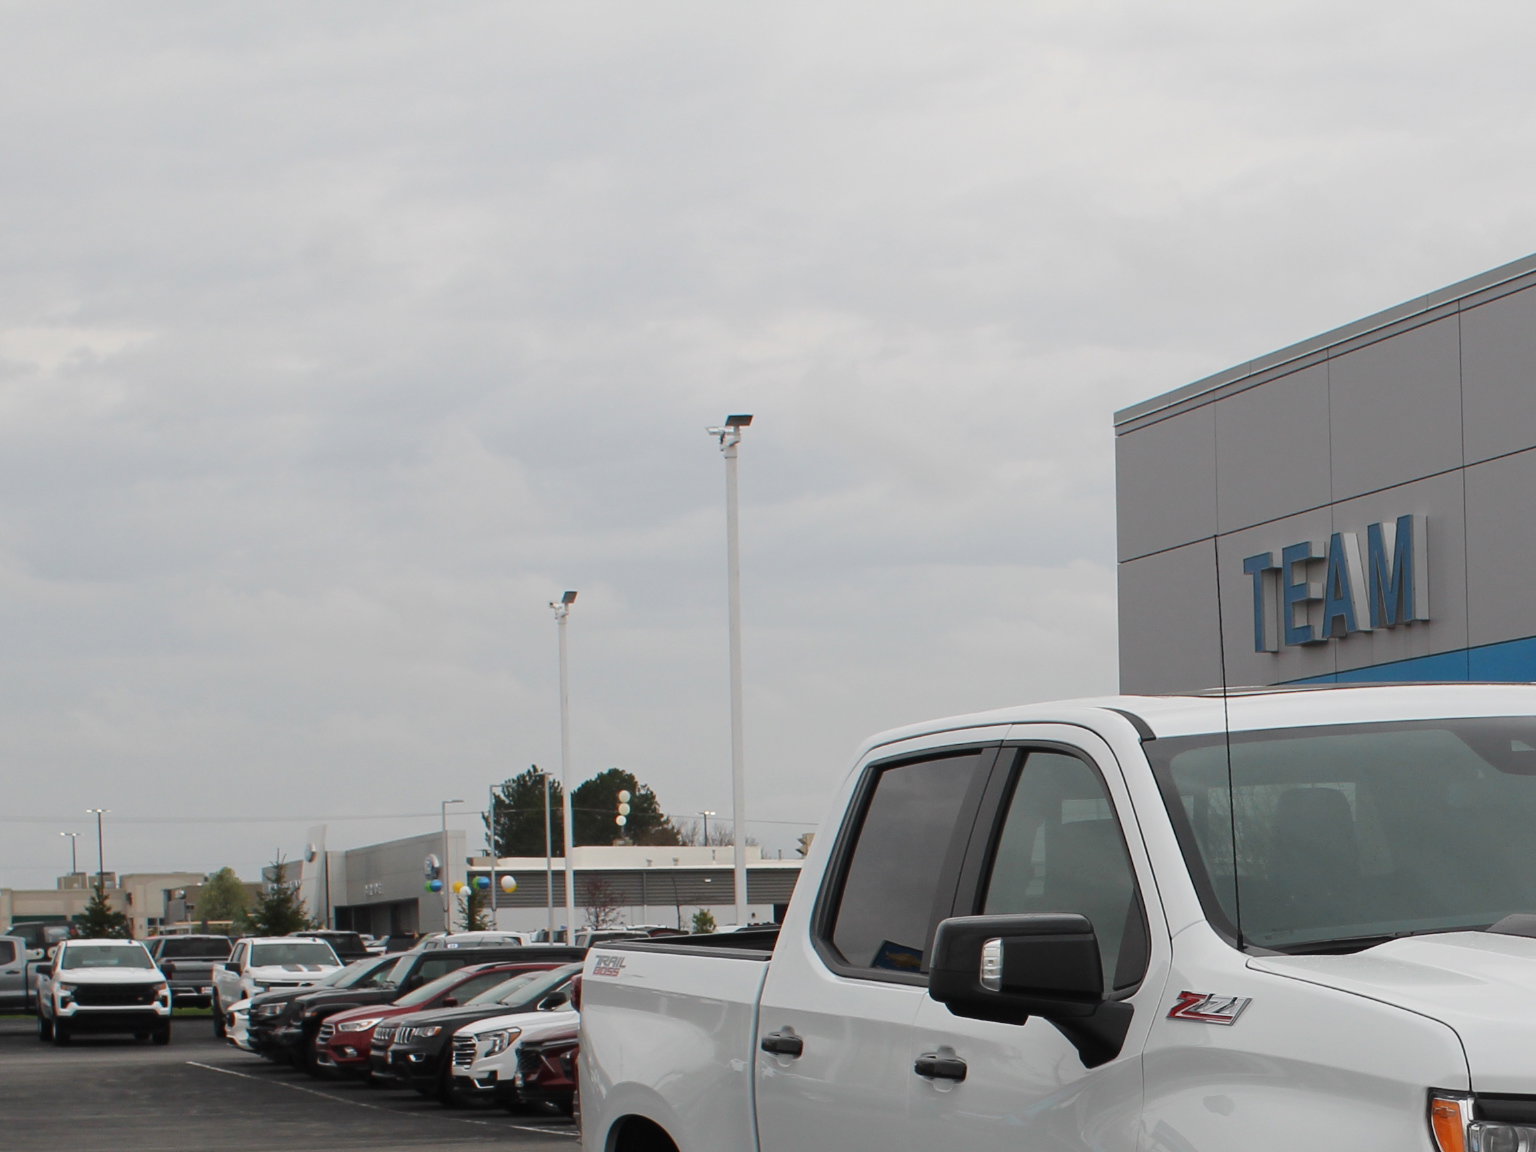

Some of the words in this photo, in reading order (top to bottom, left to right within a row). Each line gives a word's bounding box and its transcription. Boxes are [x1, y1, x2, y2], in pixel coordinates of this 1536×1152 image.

[1243, 514, 1429, 653] TEAM
[593, 967, 620, 977] BOSS
[595, 955, 626, 968] TRAIL
[1166, 990, 1253, 1027] Z71
